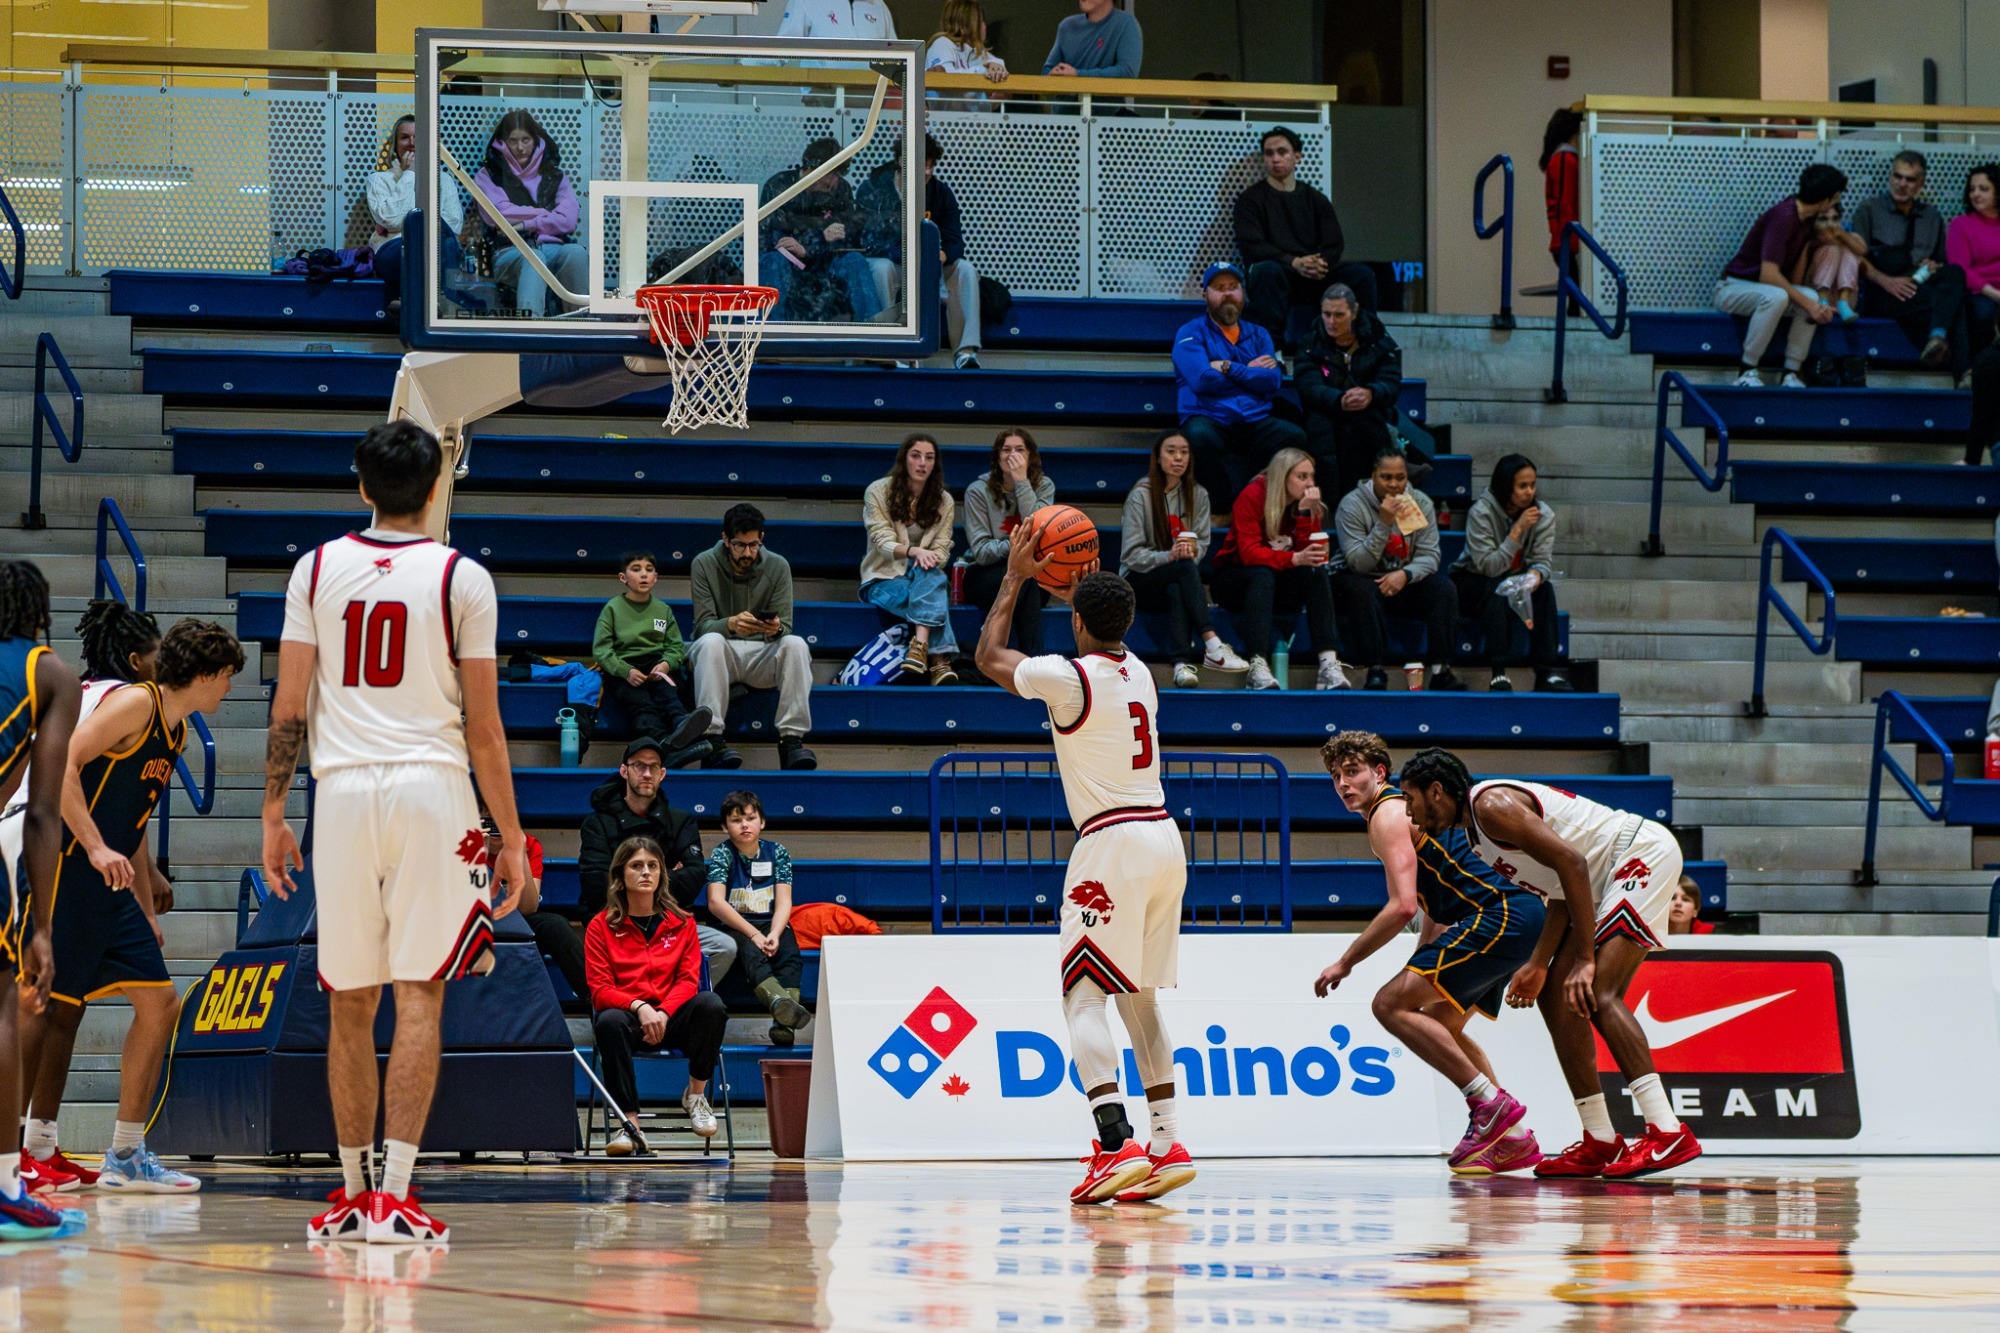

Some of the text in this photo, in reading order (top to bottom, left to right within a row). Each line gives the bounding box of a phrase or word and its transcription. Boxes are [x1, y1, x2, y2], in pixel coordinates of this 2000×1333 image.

[342, 600, 407, 688] 10
[1127, 701, 1153, 770] 3
[469, 867, 488, 889] YU
[1081, 910, 1098, 928] YU
[194, 961, 288, 1035] GAELS
[996, 1025, 1395, 1098] Dmino's
